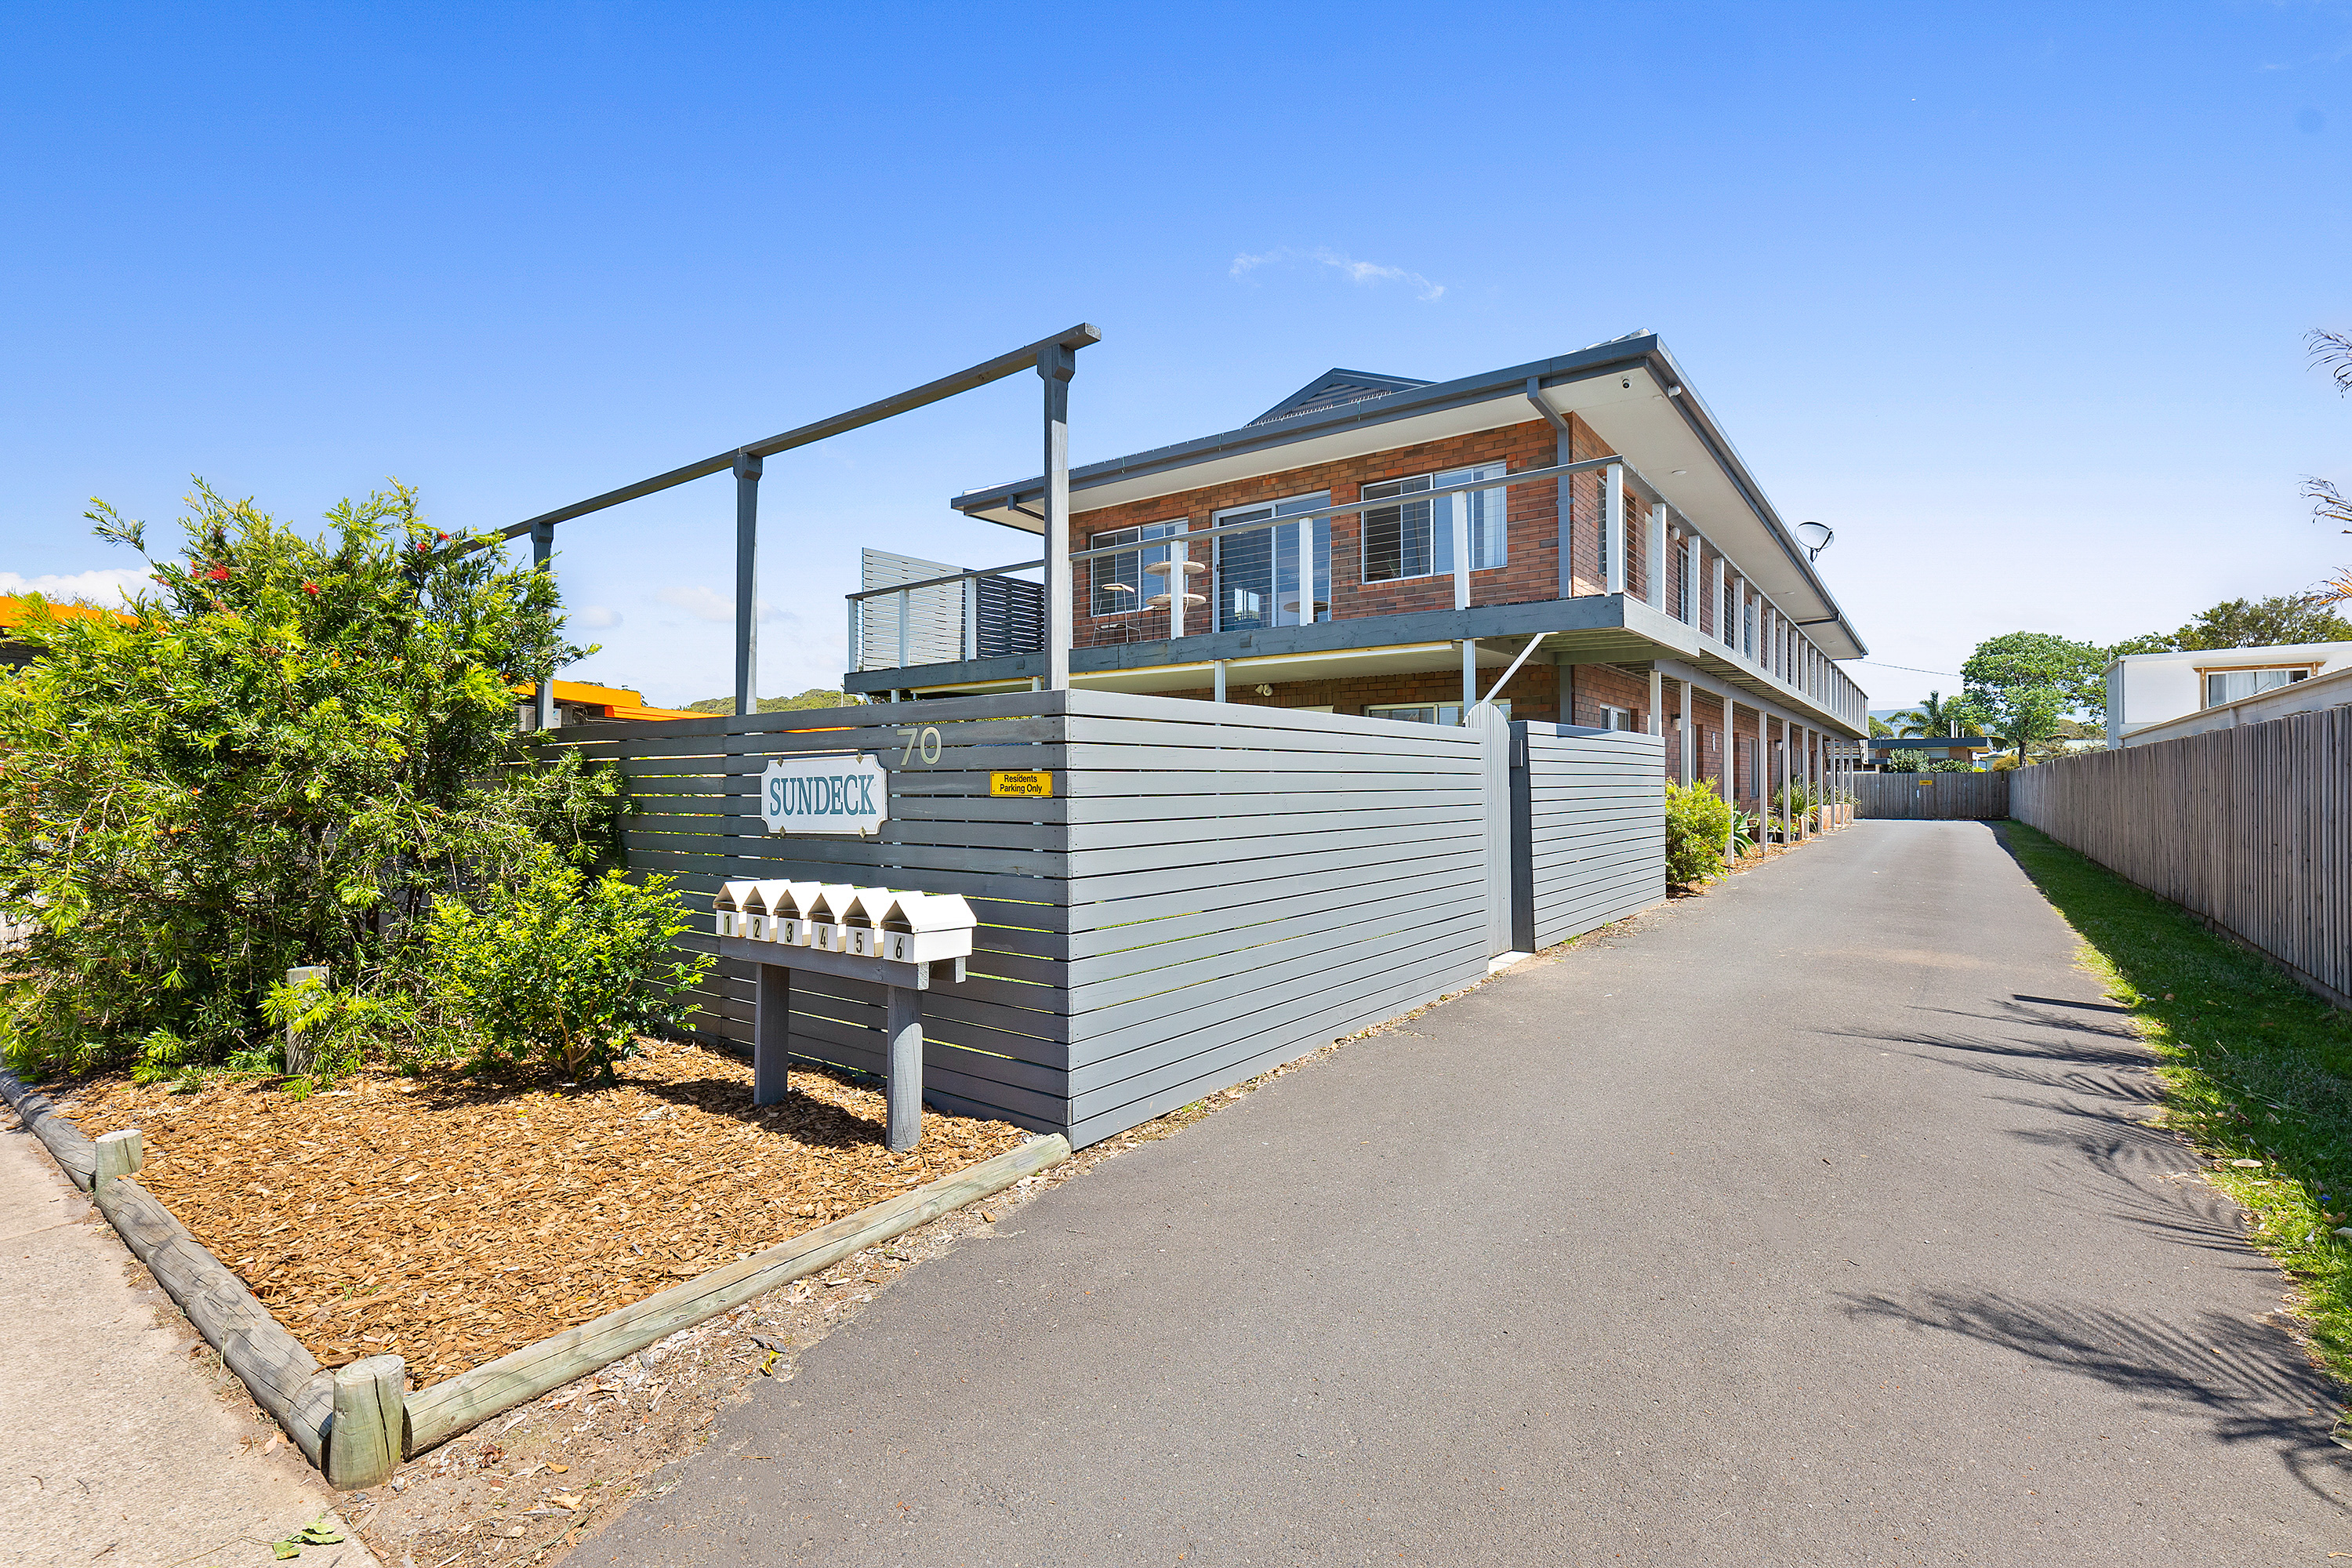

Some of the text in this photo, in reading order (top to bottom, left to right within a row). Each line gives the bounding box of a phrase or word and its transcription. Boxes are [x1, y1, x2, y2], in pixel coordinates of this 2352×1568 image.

[896, 726, 942, 766] 70
[770, 774, 877, 816] SUNDECK
[1000, 784, 1043, 793] Parking Only
[725, 915, 731, 934] 1
[755, 919, 760, 938] 2
[787, 923, 793, 943] 3
[820, 927, 826, 948] 4
[856, 932, 862, 953] 5
[896, 938, 902, 960] 6
